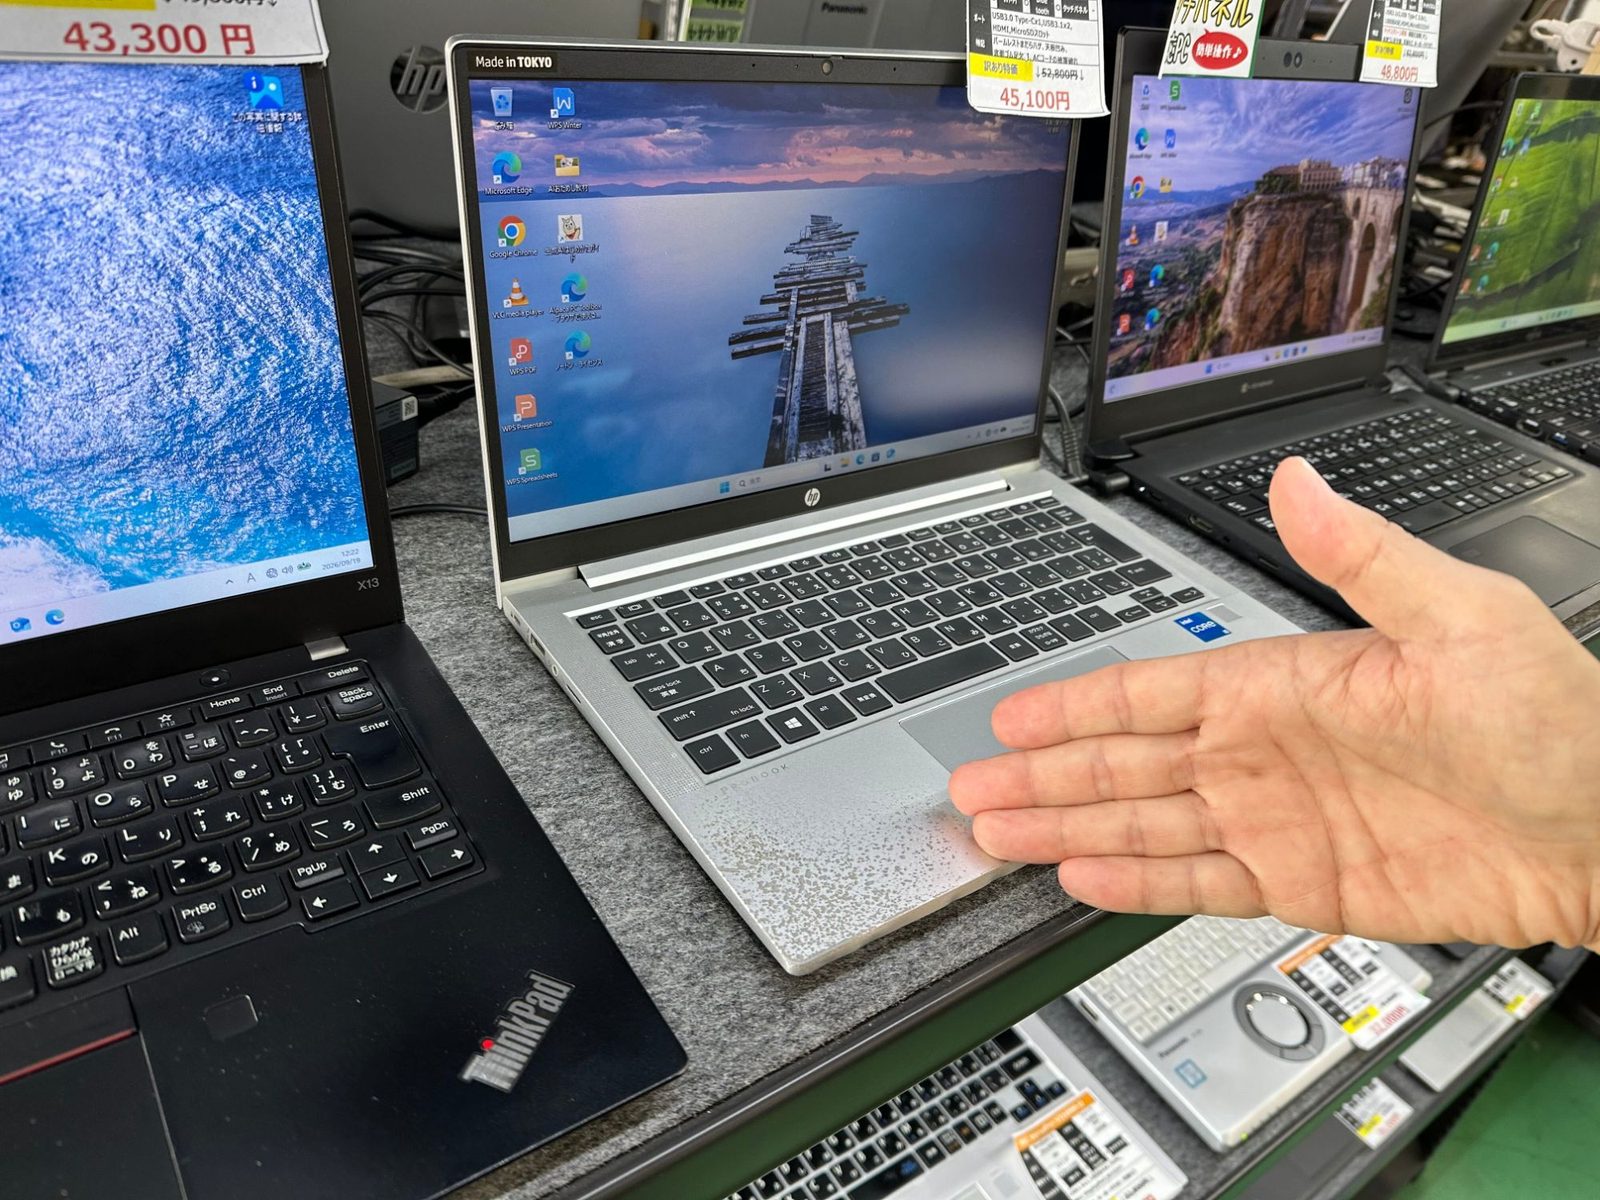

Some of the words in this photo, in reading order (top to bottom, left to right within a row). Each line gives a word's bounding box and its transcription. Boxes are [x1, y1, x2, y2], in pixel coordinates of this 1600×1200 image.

[63, 22, 208, 56] 43,300
[219, 24, 256, 55] 円
[475, 56, 504, 69] Made
[506, 56, 517, 68] in
[517, 57, 552, 68] TOKYO
[395, 46, 447, 112] hp
[1381, 64, 1418, 82] 48,800円
[1000, 87, 1070, 111] 45,100円
[484, 186, 515, 196] Microsoft
[515, 185, 533, 196] Edge
[489, 249, 513, 260] Google
[502, 423, 519, 433] WPS
[519, 420, 553, 431] Presentation
[805, 488, 820, 507] hp
[357, 578, 380, 592] X13
[624, 658, 638, 666] tab
[714, 664, 725, 673] A
[327, 665, 359, 679] Delete
[262, 685, 284, 696] End
[339, 687, 366, 699] Back
[648, 684, 666, 693] caps
[209, 696, 240, 709] Home
[342, 690, 373, 704] space
[359, 719, 390, 734] Enter
[699, 745, 713, 754] ctrl
[52, 779, 65, 790] 9
[163, 774, 177, 788] P
[194, 779, 209, 790] せ
[94, 792, 113, 806] O
[281, 794, 294, 805] け
[401, 786, 430, 802] Shift
[129, 797, 142, 808] ら
[225, 810, 241, 822] れ
[53, 817, 71, 831] に
[343, 820, 356, 831] ろ
[421, 820, 449, 836] PgDn
[122, 829, 138, 842] L
[159, 829, 171, 841] り
[275, 840, 290, 852] め
[48, 848, 67, 864] K
[81, 852, 99, 865] の
[297, 861, 327, 877] PgUp
[241, 884, 267, 900] Ctrl
[56, 909, 71, 923] も
[181, 901, 217, 920] PrtSc
[118, 926, 139, 942] Alt
[460, 971, 574, 1092] ThinkPad
